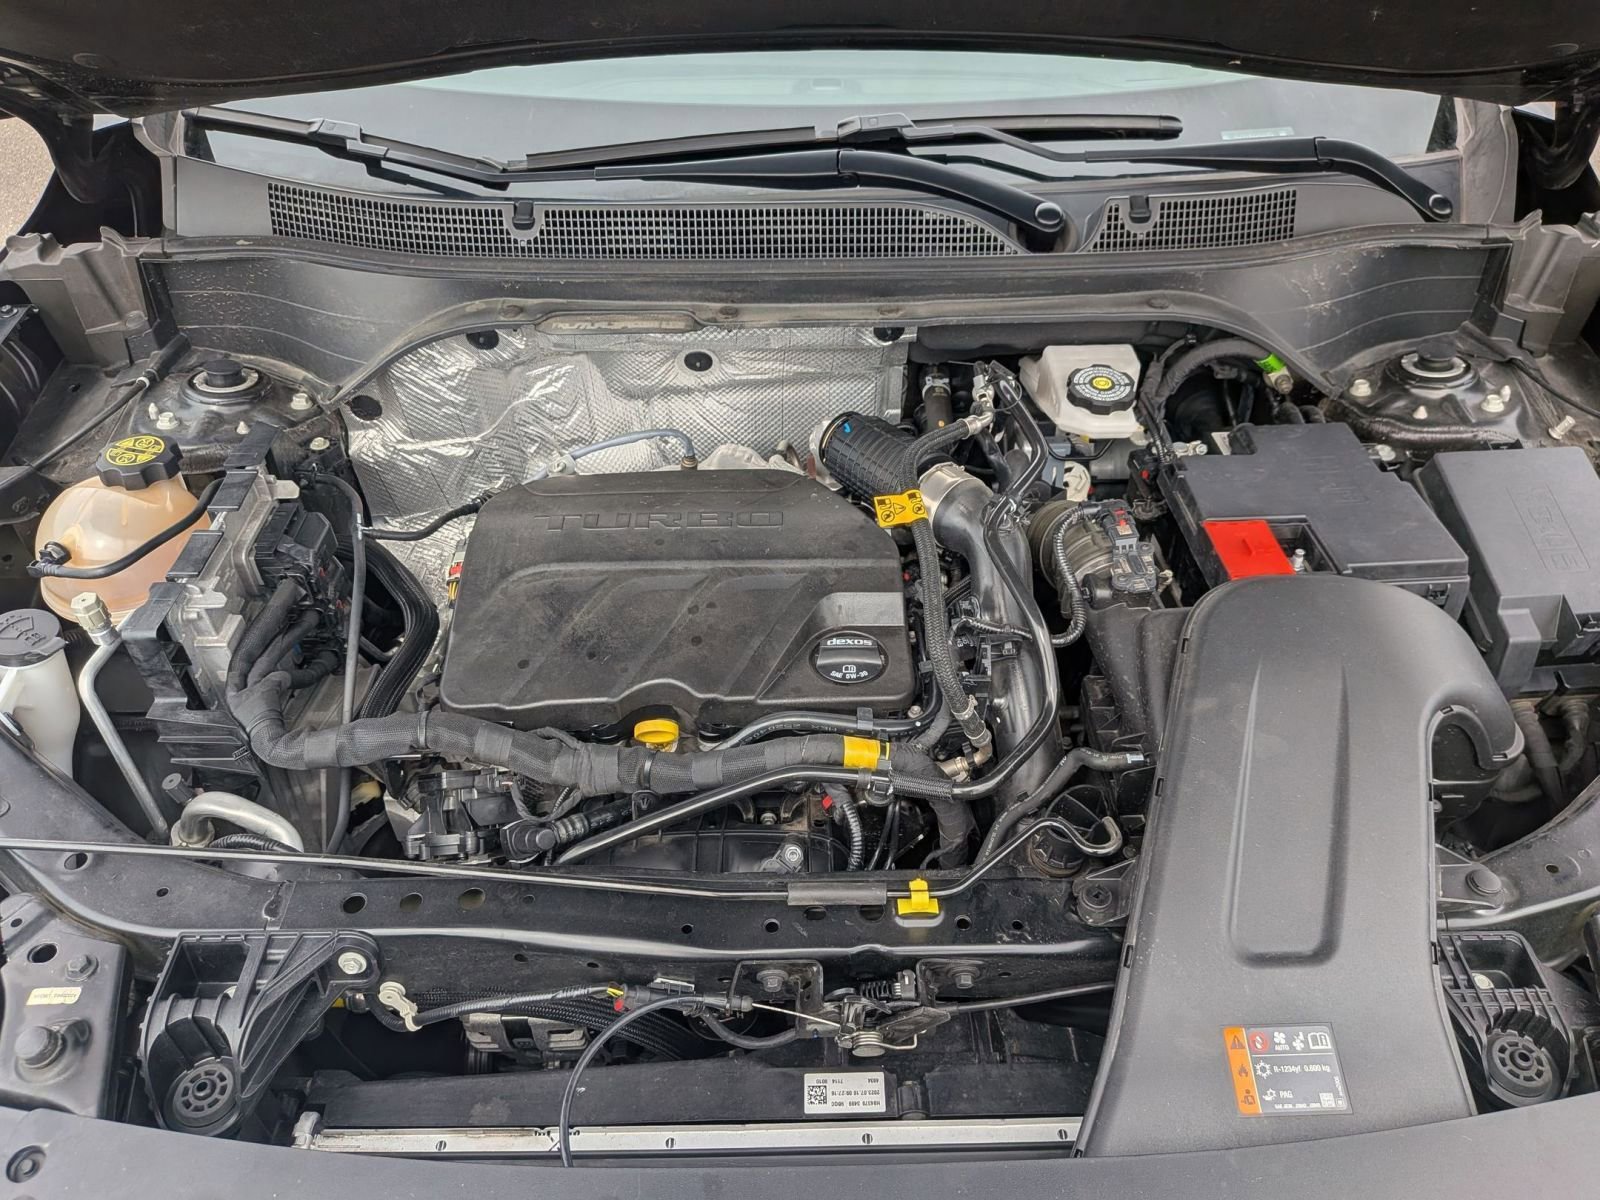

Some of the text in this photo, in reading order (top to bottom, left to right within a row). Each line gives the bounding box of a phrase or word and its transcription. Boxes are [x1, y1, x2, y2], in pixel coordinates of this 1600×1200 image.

[534, 510, 784, 532] TURBO
[826, 637, 873, 646] dexos
[830, 670, 869, 679] SAE 5W-30
[1273, 1065, 1301, 1074] R-1234yf
[1320, 1064, 1331, 1073] kg
[1279, 1090, 1294, 1099] PAG
